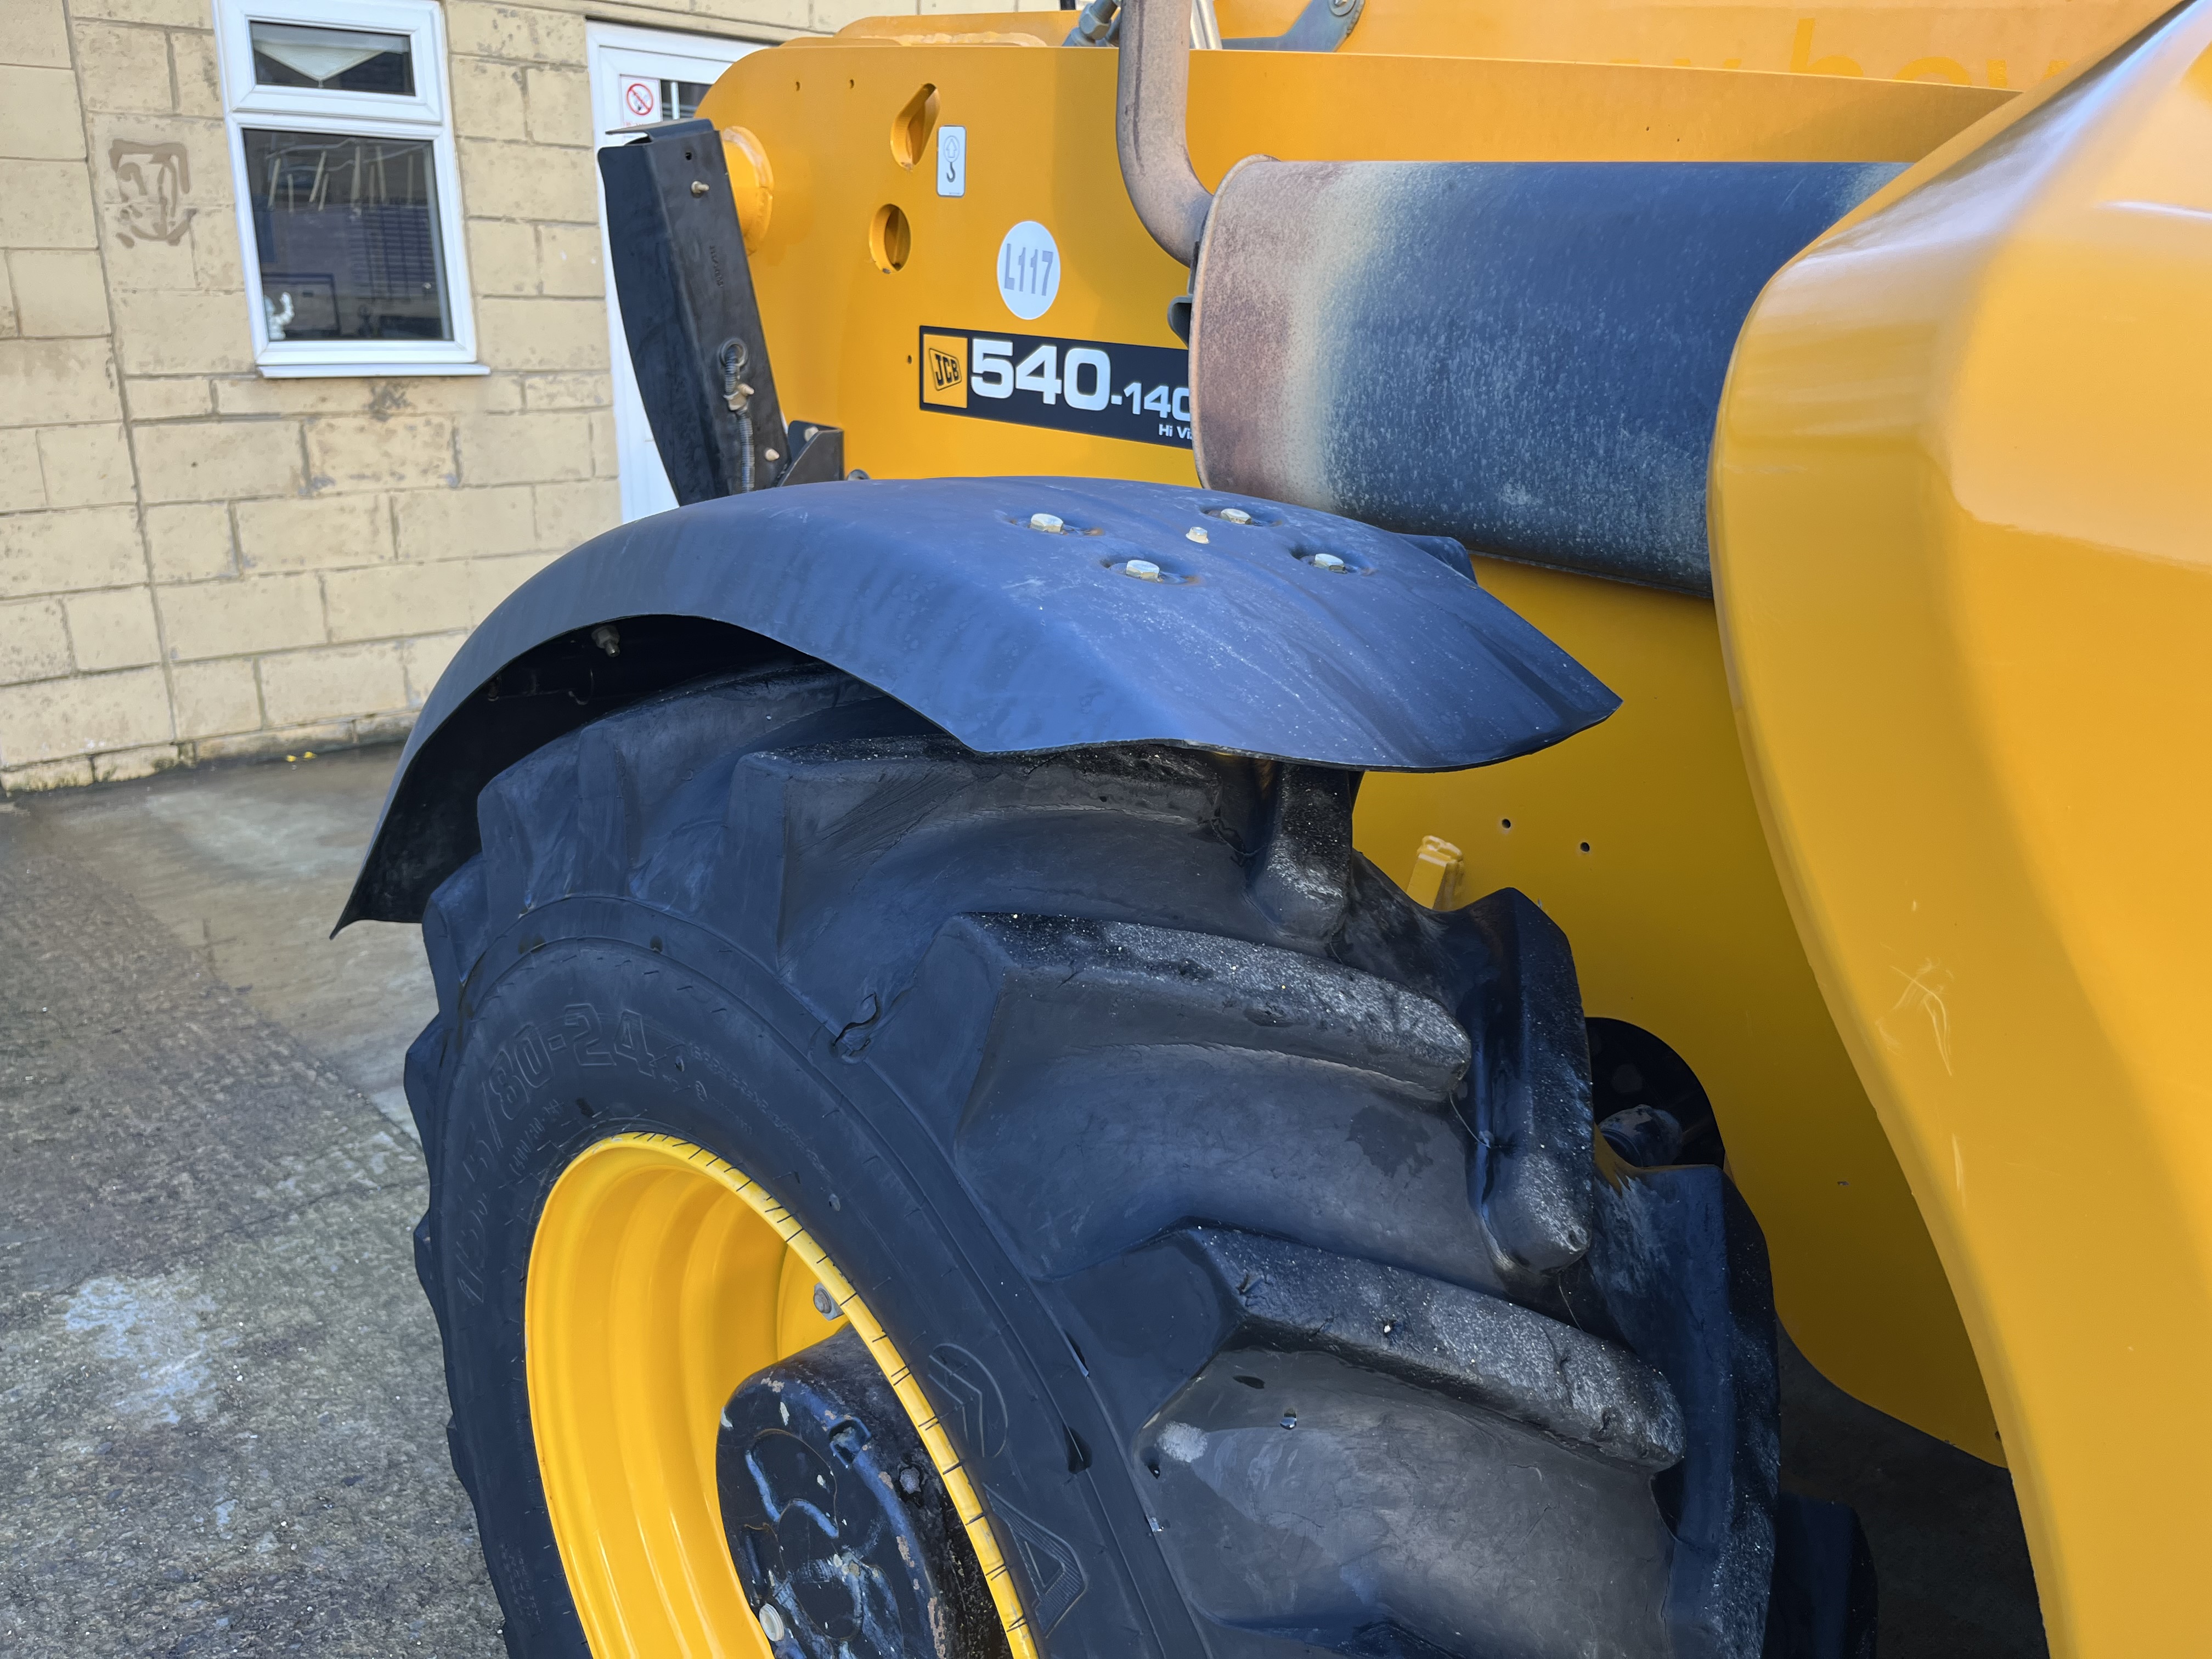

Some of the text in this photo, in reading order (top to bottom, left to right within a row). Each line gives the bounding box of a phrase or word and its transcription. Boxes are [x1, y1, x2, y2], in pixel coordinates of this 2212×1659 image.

[1004, 242, 1054, 296] L117
[934, 353, 959, 387] JCB
[1159, 423, 1173, 437] Hi
